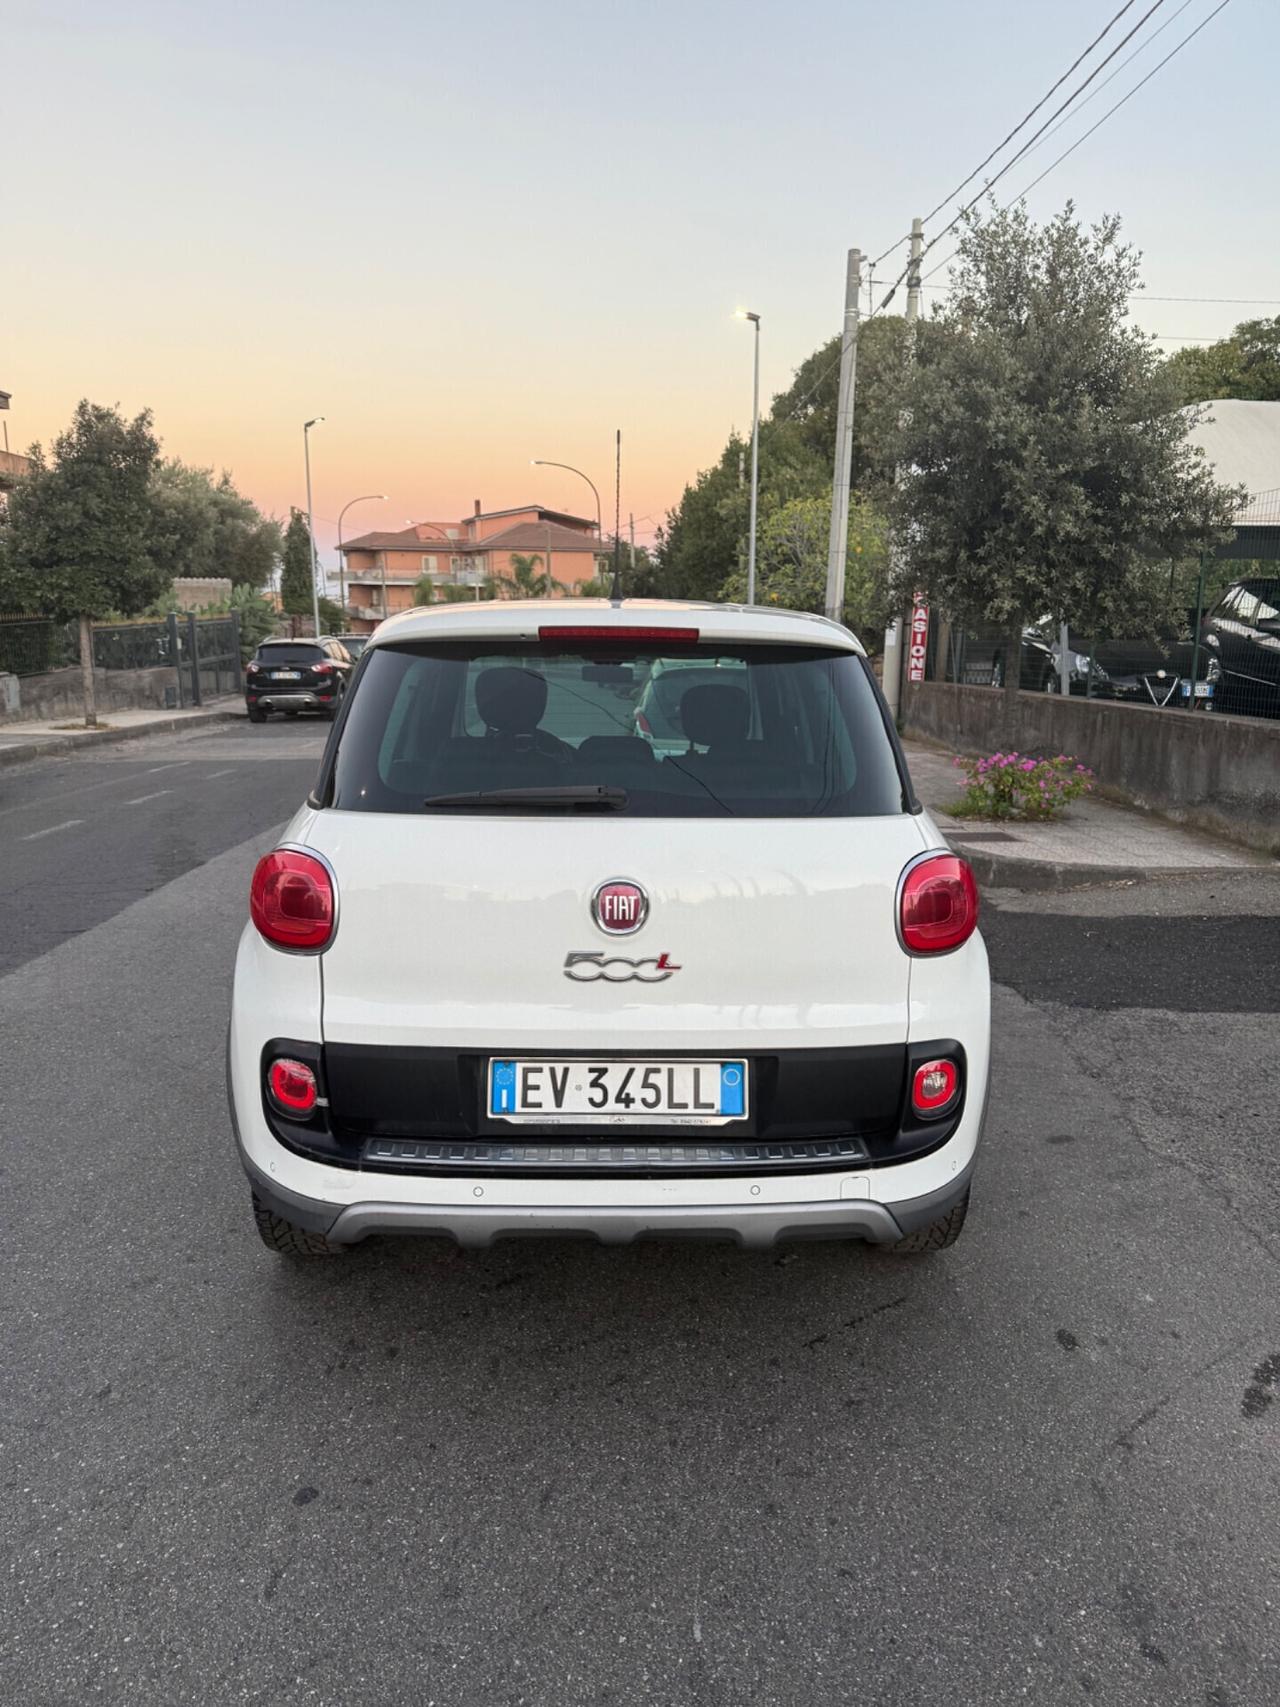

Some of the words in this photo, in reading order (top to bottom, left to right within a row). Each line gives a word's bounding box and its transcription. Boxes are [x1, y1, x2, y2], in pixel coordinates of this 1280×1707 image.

[604, 895, 638, 921] FIAT
[564, 951, 682, 982] 500L
[521, 1066, 570, 1109] EV
[587, 1066, 715, 1110] 345LL
